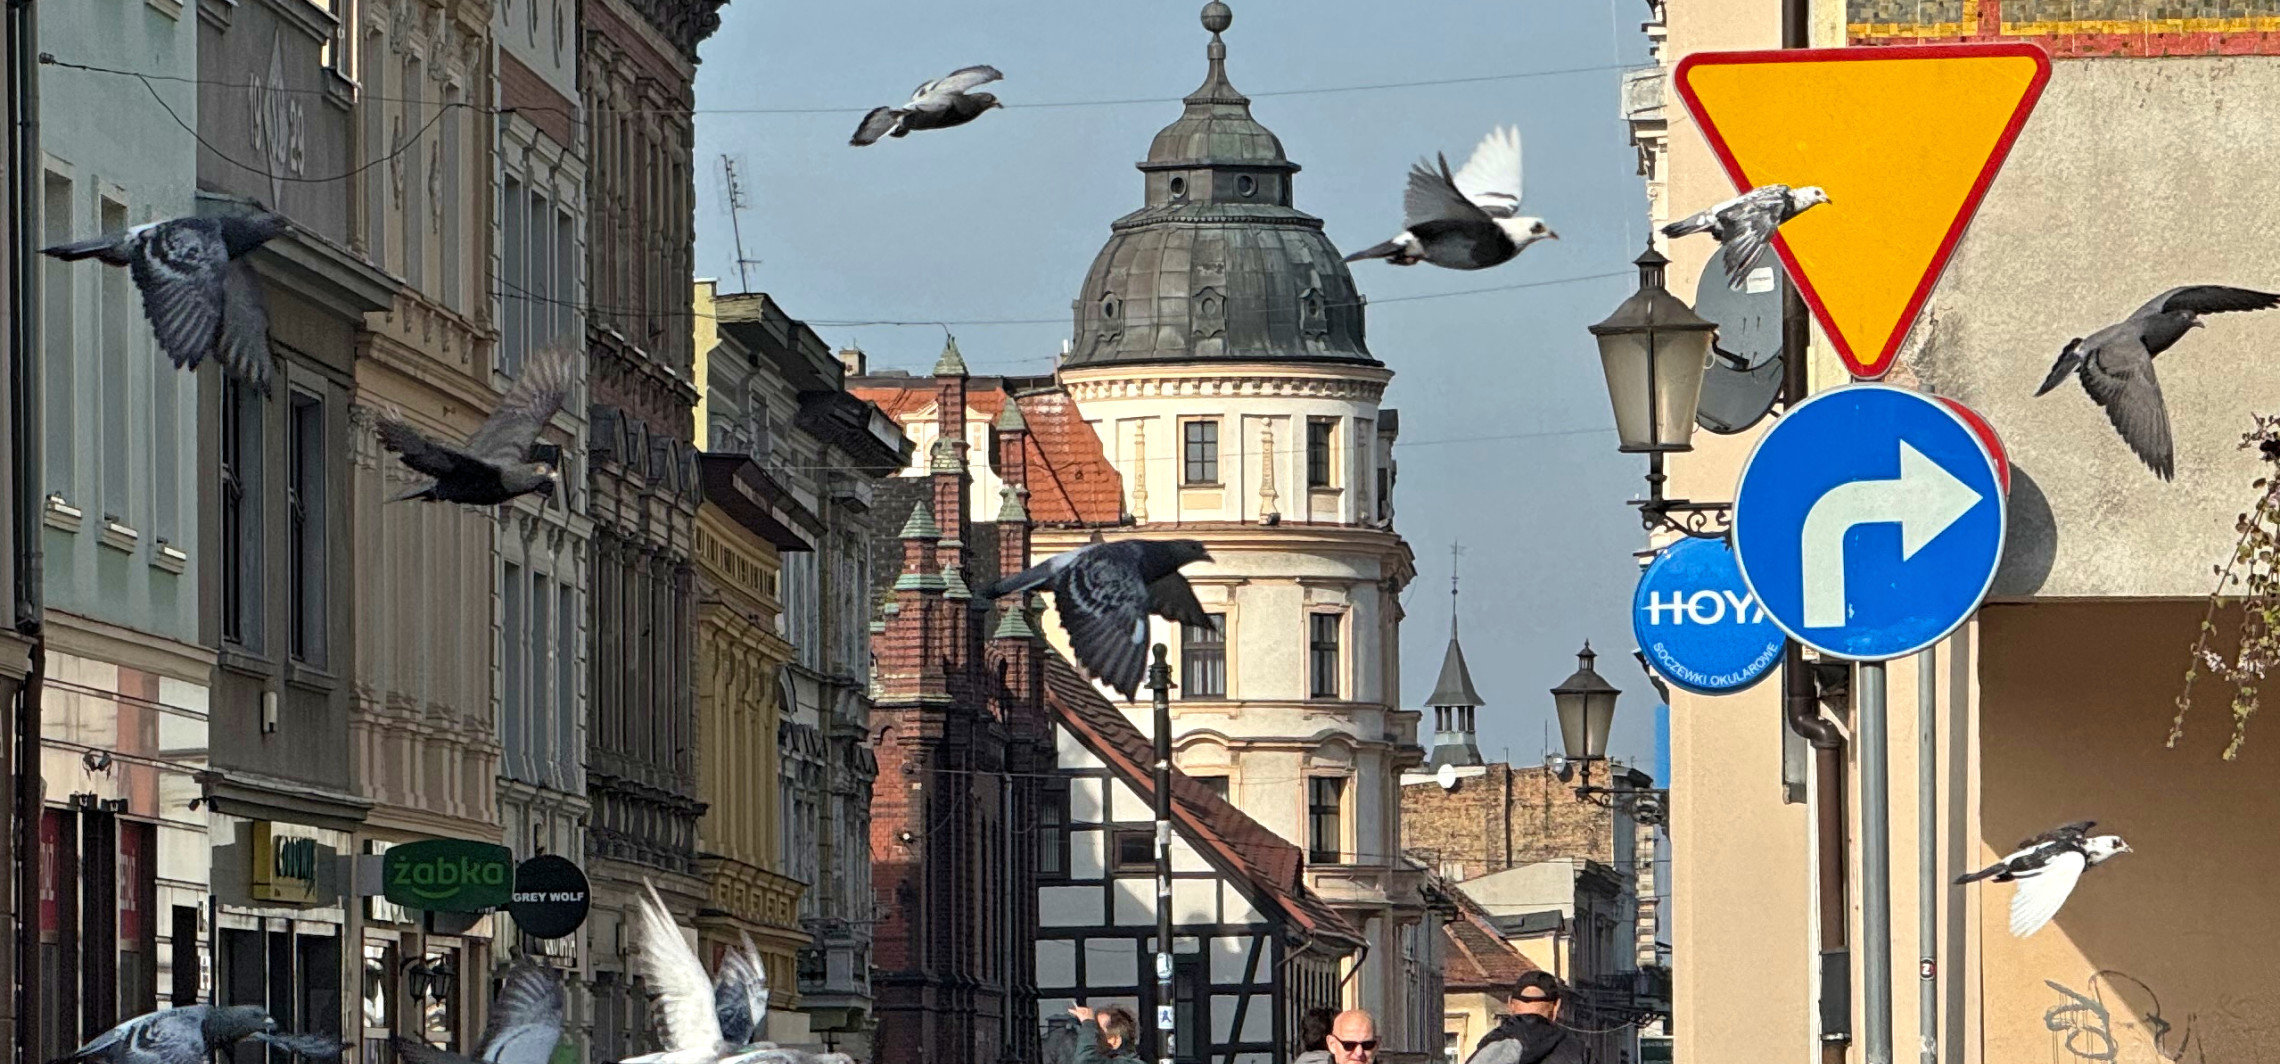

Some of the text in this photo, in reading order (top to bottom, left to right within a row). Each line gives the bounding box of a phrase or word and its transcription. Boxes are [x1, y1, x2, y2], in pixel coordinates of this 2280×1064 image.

[249, 72, 261, 151] 19
[289, 99, 304, 176] 29
[1653, 642, 1778, 686] SOCZEWKI OKULAROWE
[393, 856, 504, 885] żabka
[513, 892, 584, 902] GREY WOLF
